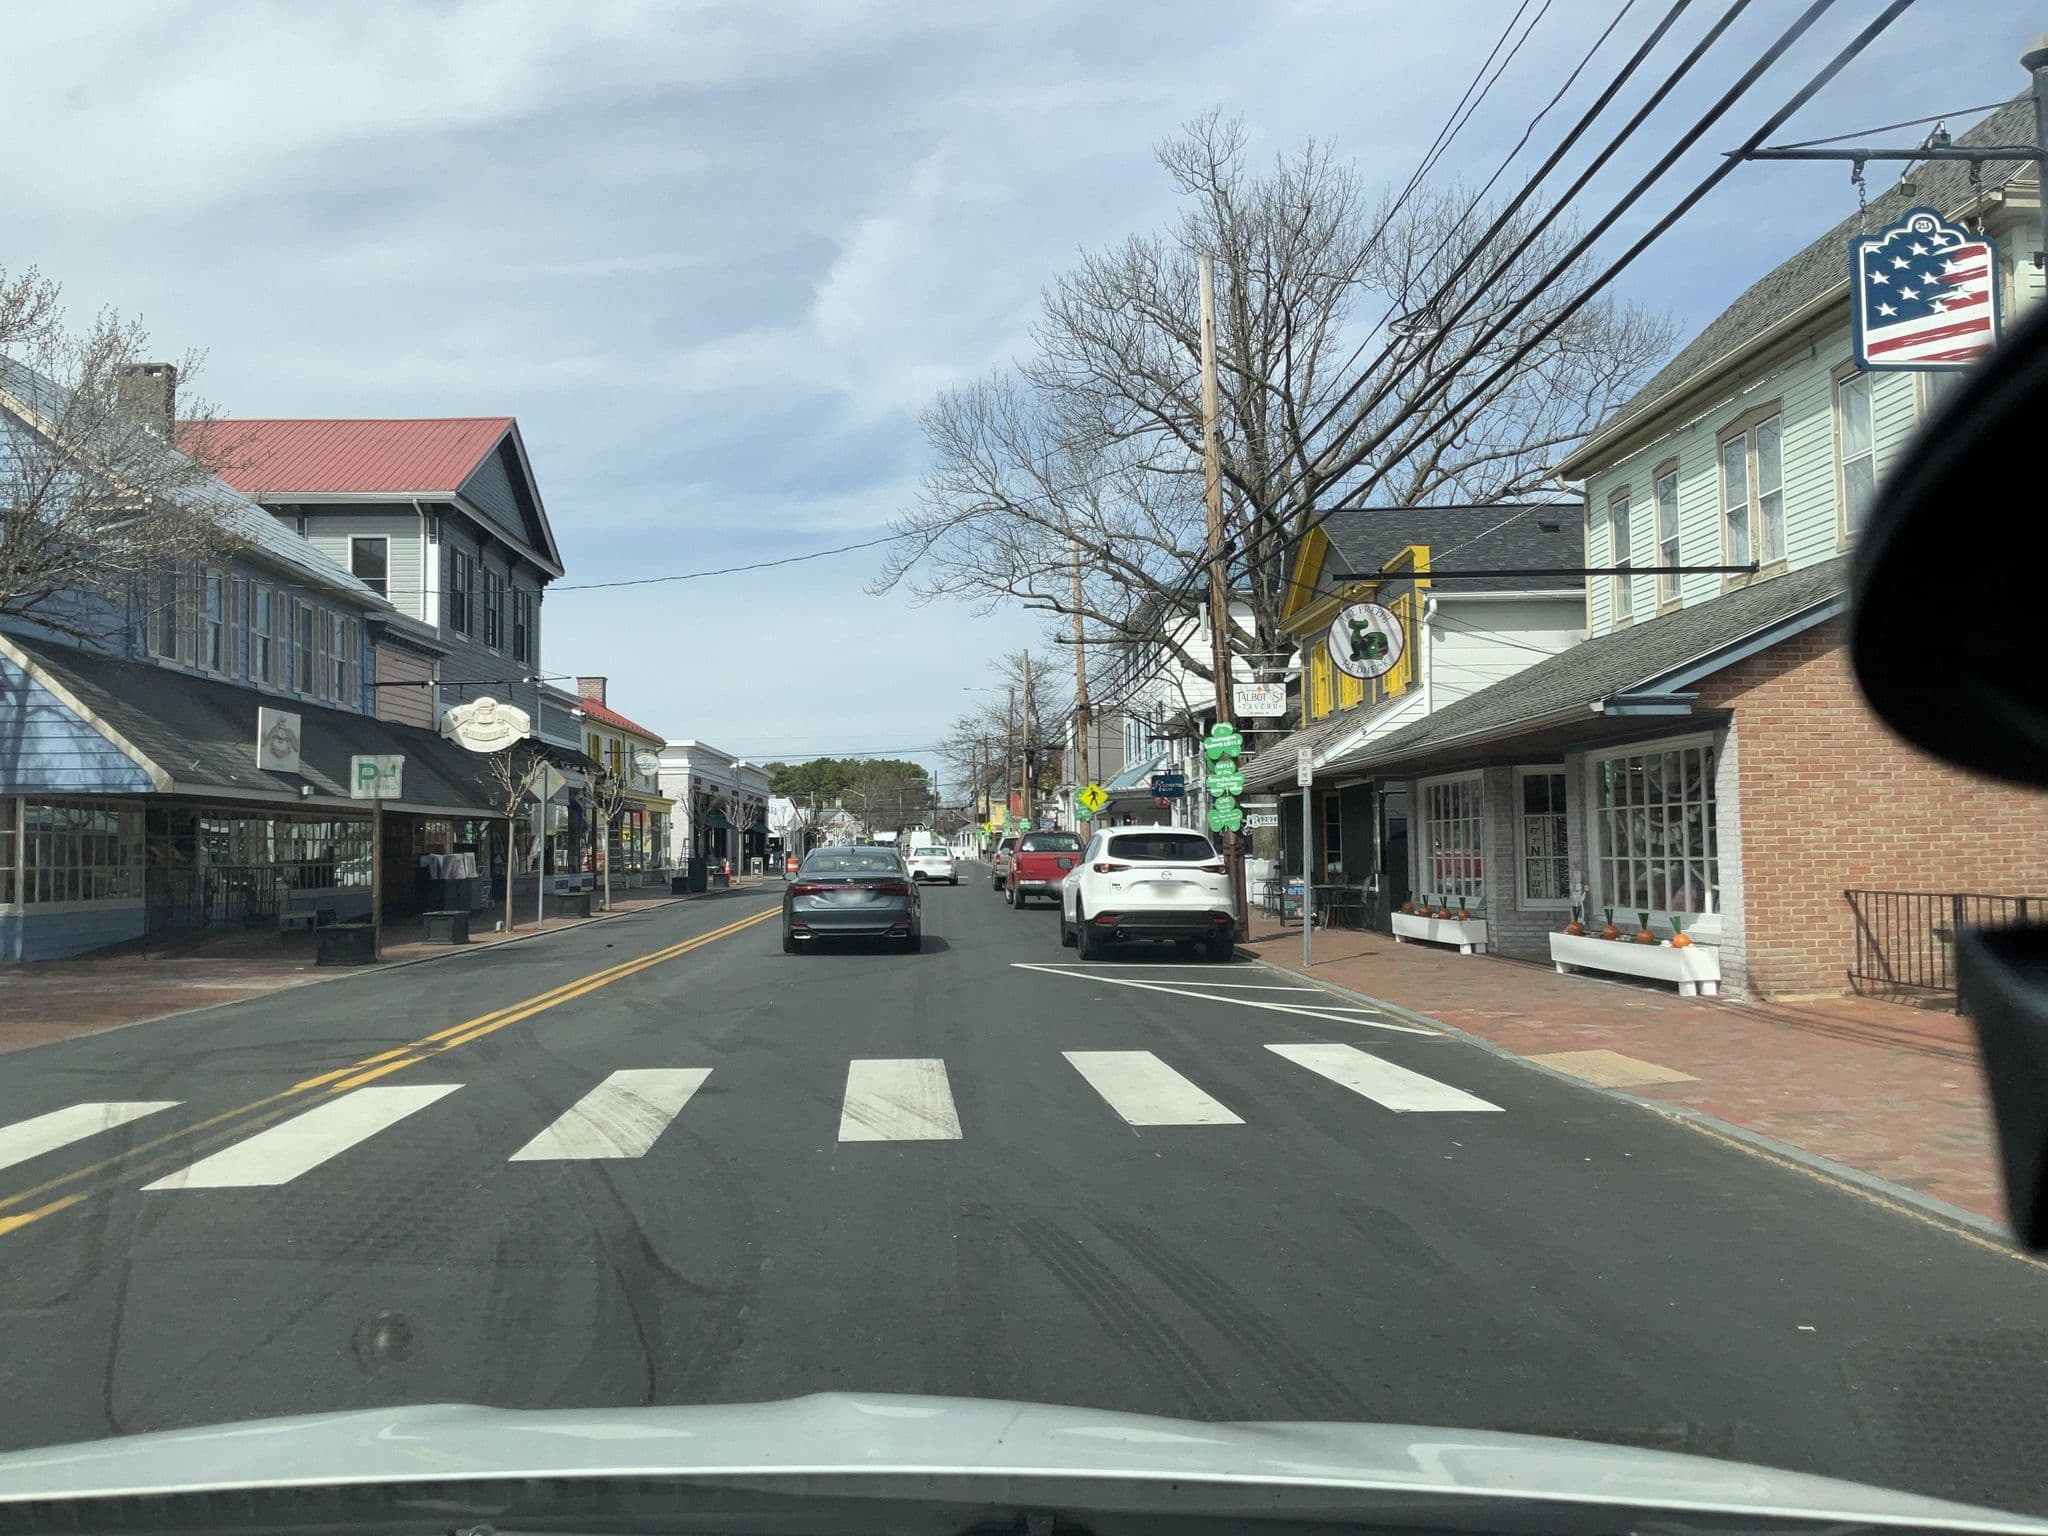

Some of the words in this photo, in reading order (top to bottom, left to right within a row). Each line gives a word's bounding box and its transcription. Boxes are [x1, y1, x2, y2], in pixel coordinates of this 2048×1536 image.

[1340, 609, 1357, 623] THE
[1358, 606, 1392, 624] PREPPY
[1342, 658, 1391, 674] REDNECK
[1236, 690, 1266, 703] TALBOT
